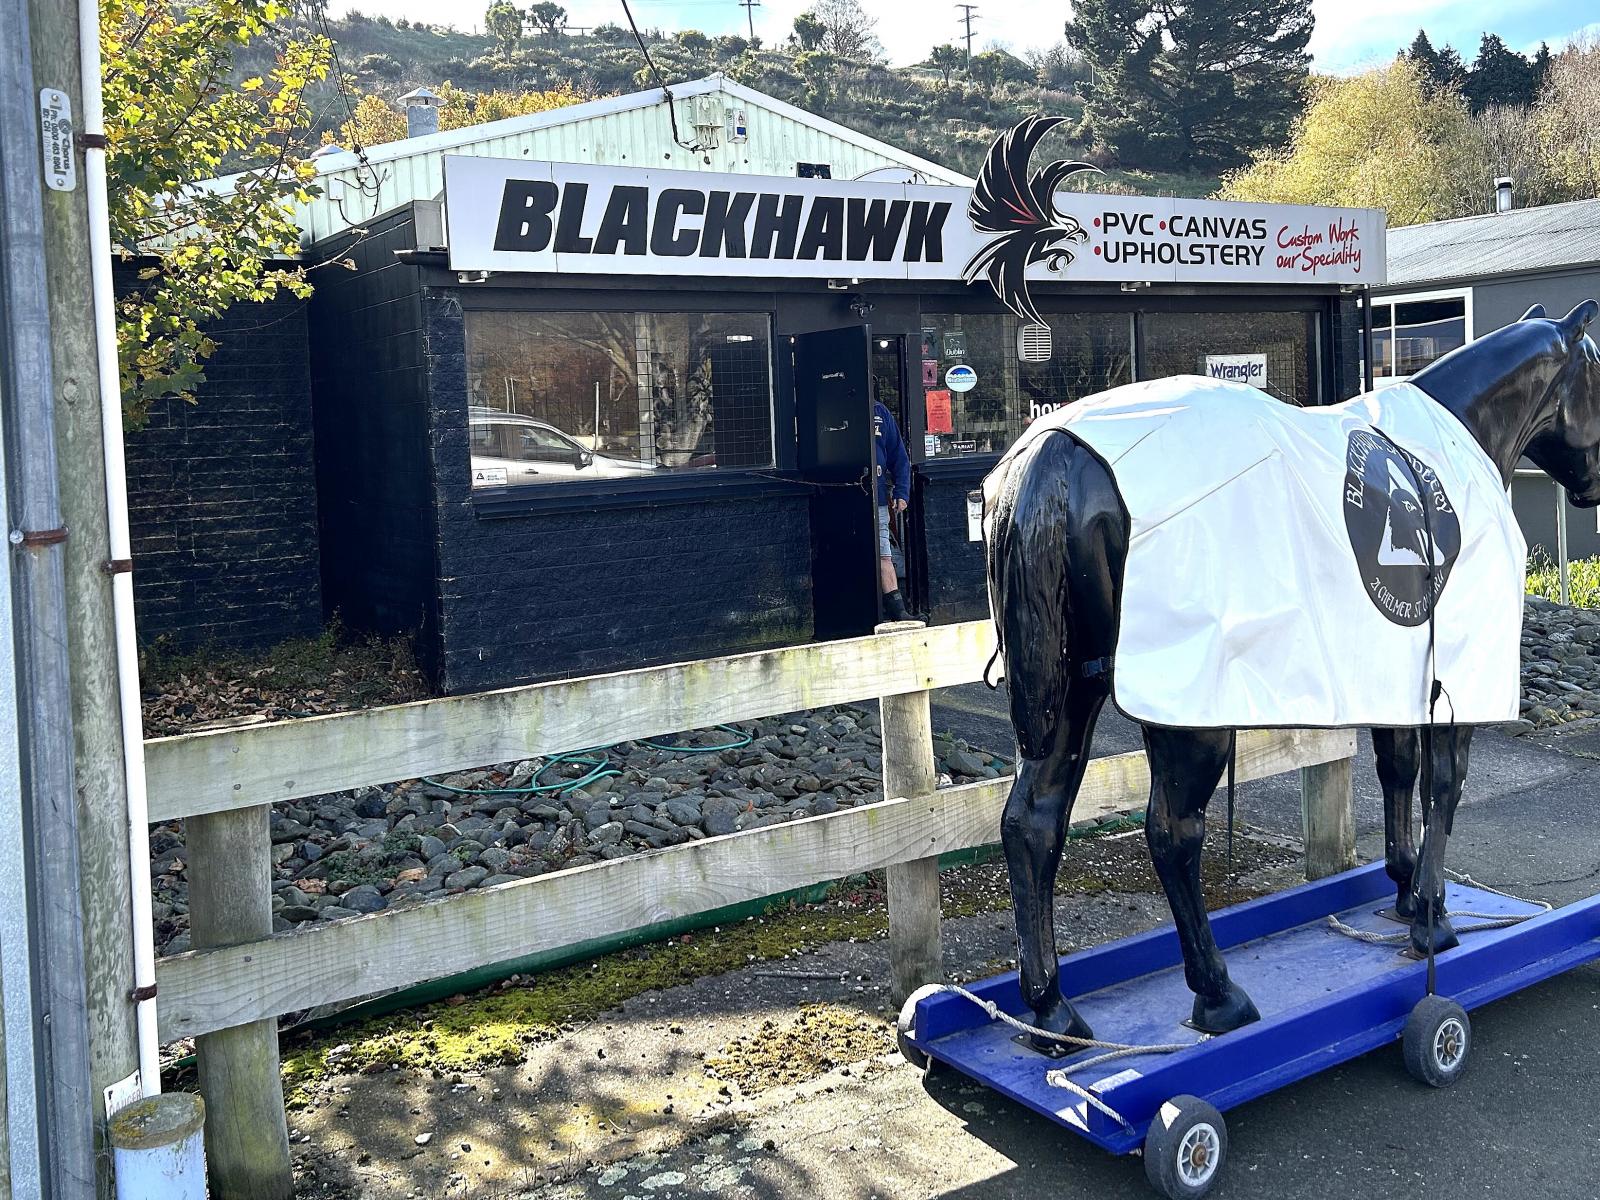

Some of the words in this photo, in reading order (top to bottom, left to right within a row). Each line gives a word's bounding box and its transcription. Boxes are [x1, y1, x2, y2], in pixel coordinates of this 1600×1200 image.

[43, 120, 51, 132] CH
[51, 122, 59, 141] 0800
[62, 138, 71, 170] Chorus
[493, 178, 952, 263] BLACKHAWK
[1103, 212, 1154, 236] PVC
[1168, 215, 1267, 240] CANVAS
[1276, 224, 1323, 249] Custom
[1328, 216, 1360, 242] Work
[1103, 241, 1266, 266] UPHOLSTERY
[1276, 253, 1302, 269] our
[1301, 246, 1362, 276] Speciality
[1210, 361, 1264, 383] Wrangler
[1346, 432, 1382, 509] BLACKHAWK
[1377, 585, 1412, 619] CHELMER
